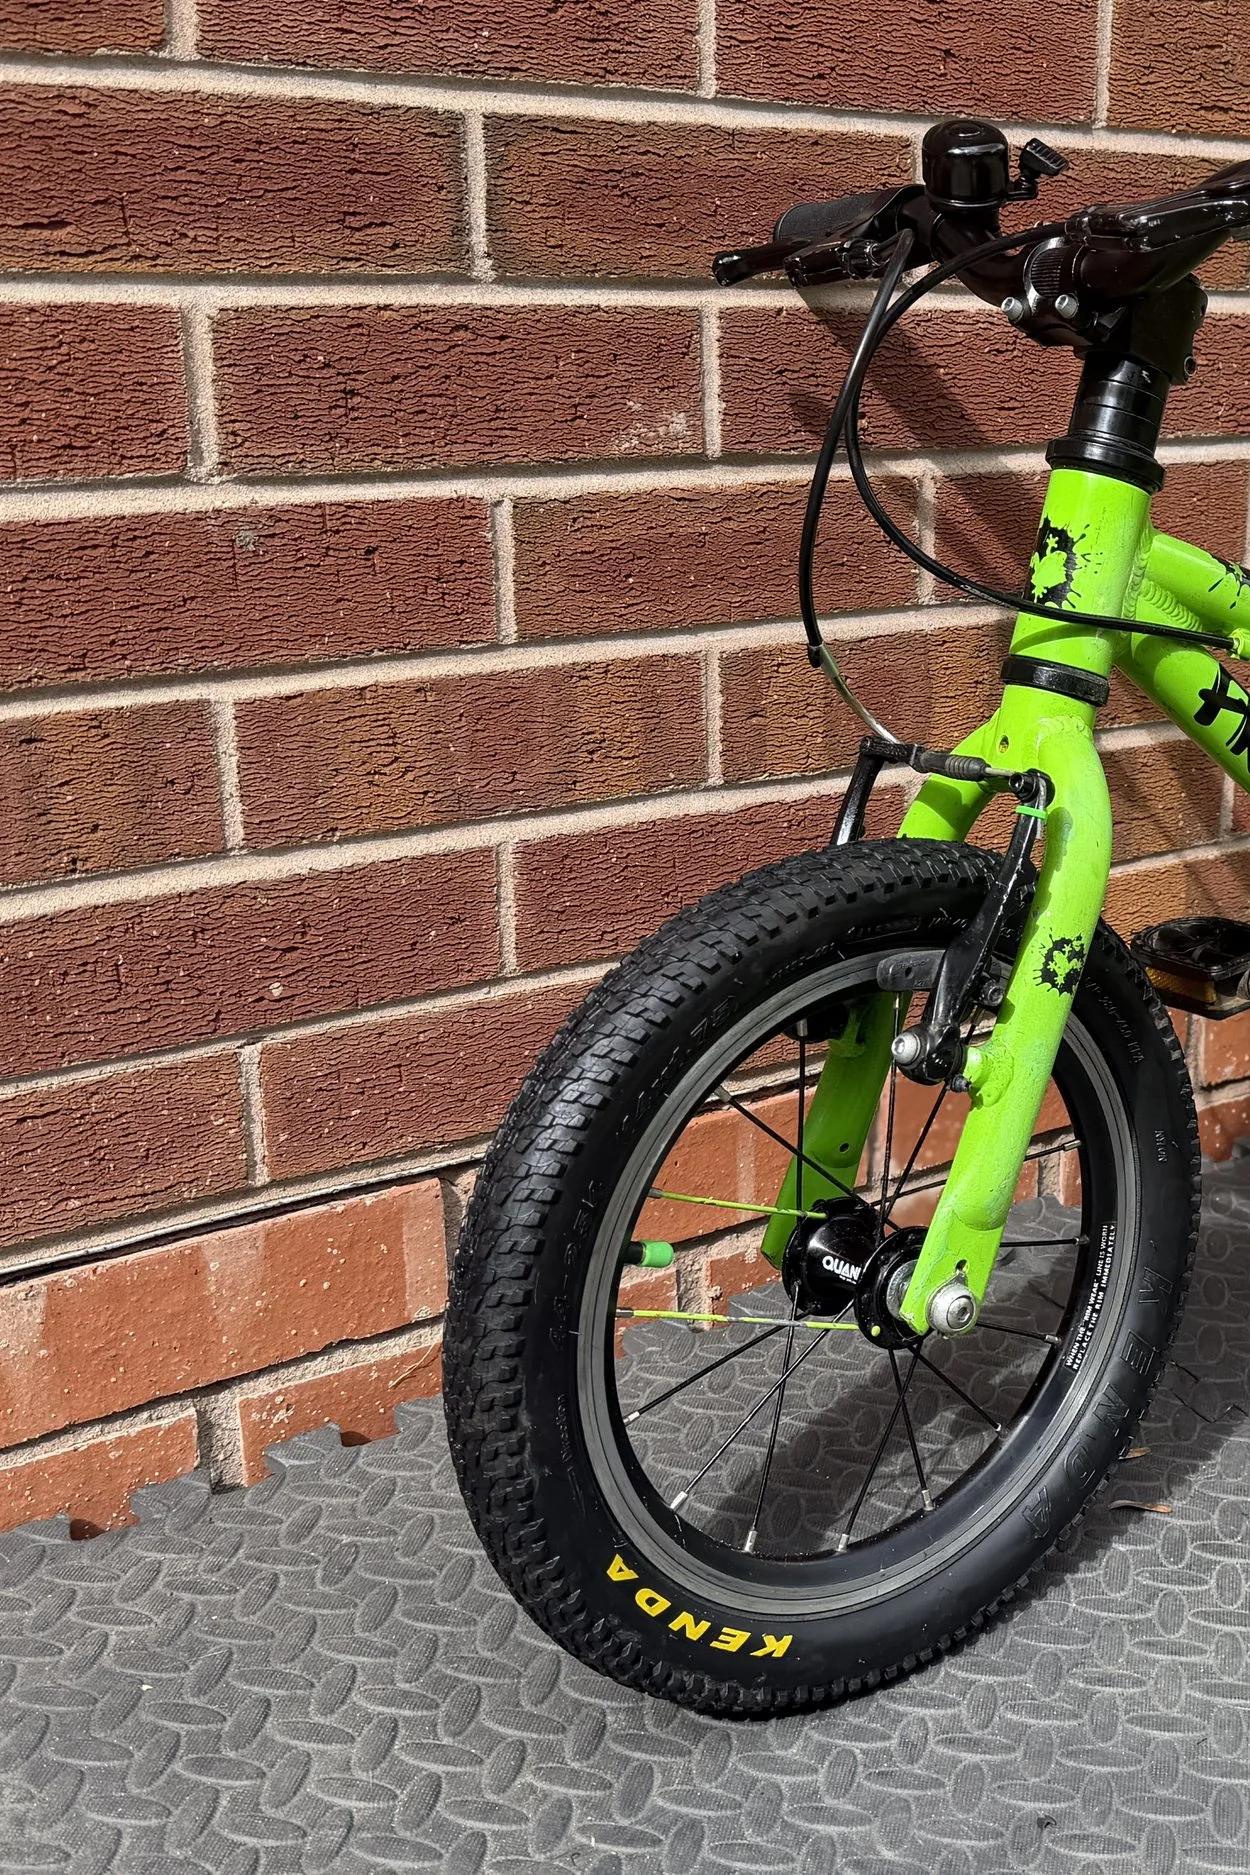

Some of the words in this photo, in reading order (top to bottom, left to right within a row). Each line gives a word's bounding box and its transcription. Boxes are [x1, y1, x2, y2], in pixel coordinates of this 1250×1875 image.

[1066, 1342, 1080, 1366] WHEN
[1076, 1327, 1086, 1341] THE
[1096, 1260, 1104, 1276] LINE
[1100, 1225, 1109, 1249] WORN
[1072, 1331, 1092, 1370] REPLACE
[1089, 1312, 1099, 1329] THE
[1095, 1291, 1105, 1310] RIM
[1100, 1225, 1116, 1287] IMMEDIATELY
[1022, 1266, 1174, 1540] KENDA
[606, 1553, 793, 1658] KENDA
